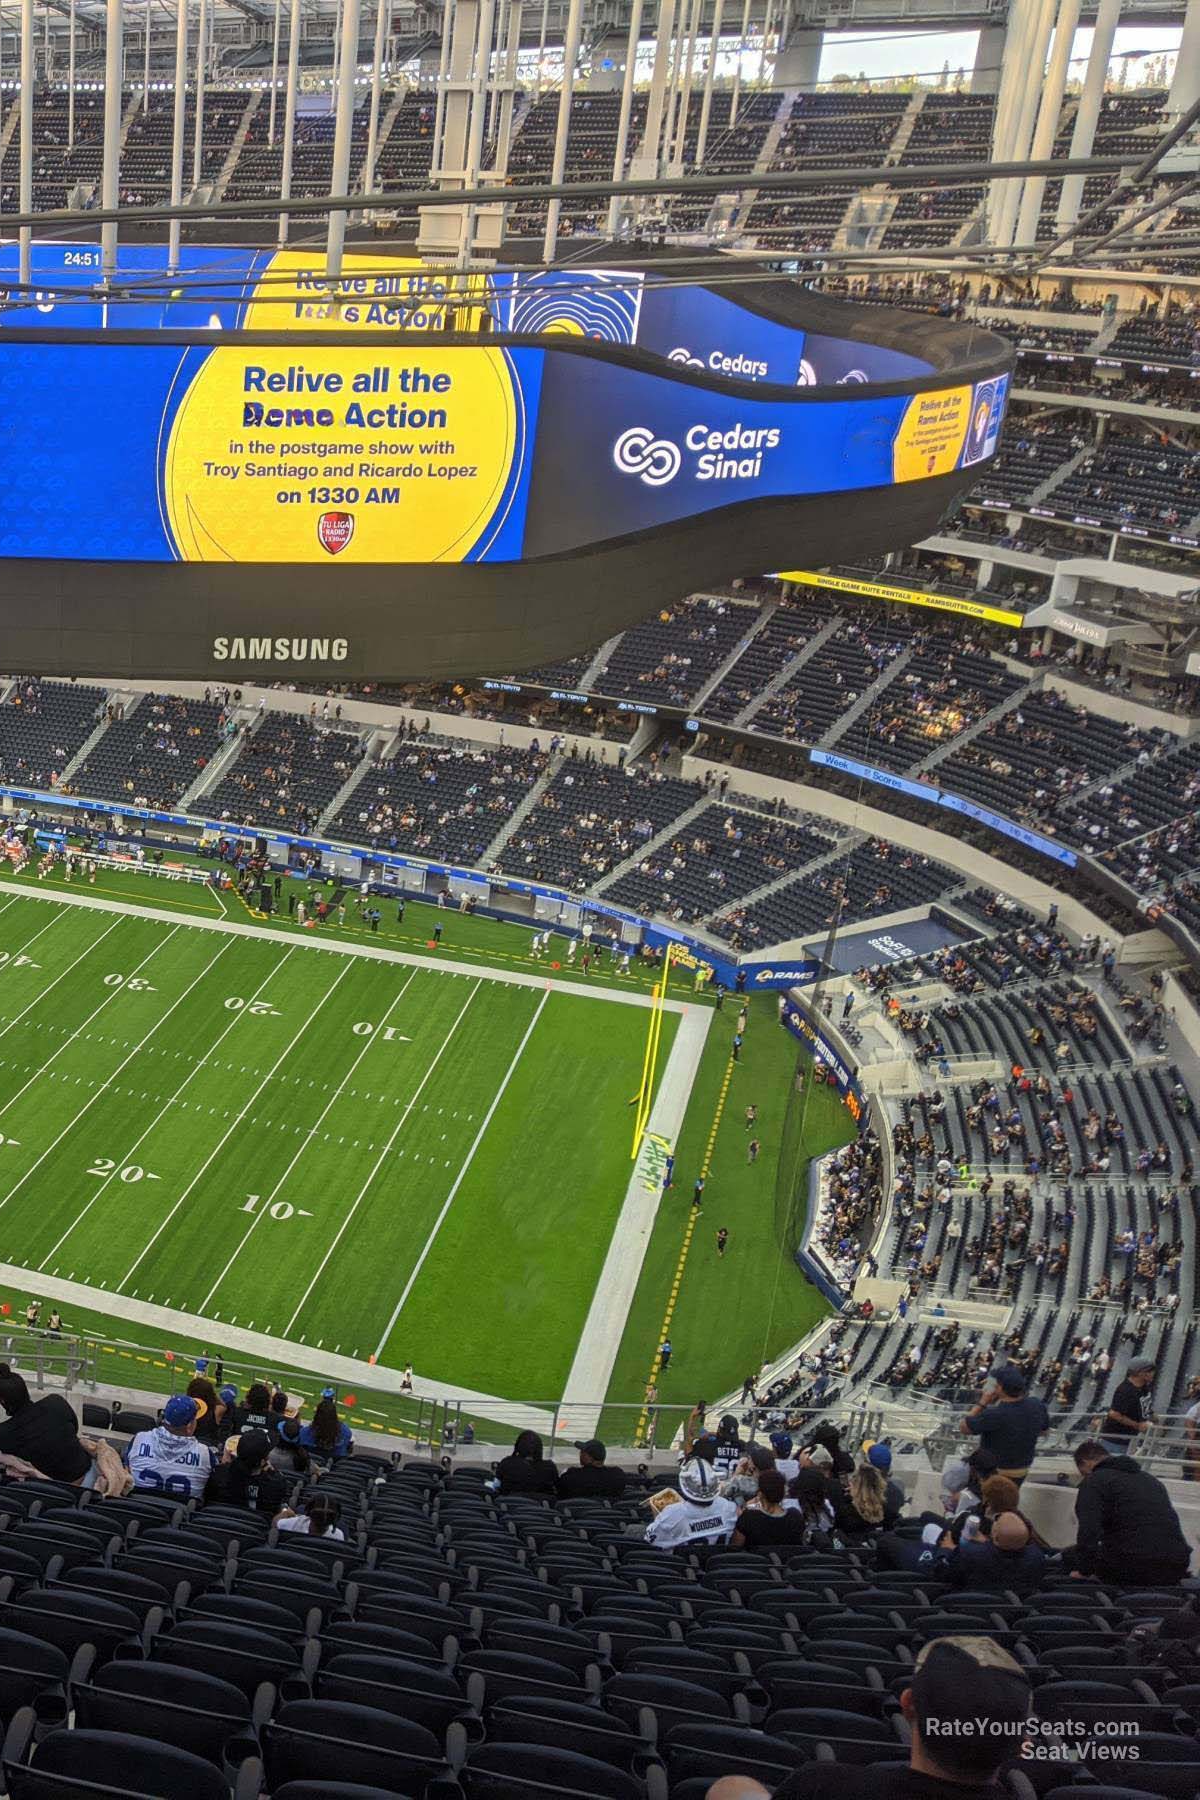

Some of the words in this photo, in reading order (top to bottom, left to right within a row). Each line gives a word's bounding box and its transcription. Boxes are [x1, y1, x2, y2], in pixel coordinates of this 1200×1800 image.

[64, 252, 100, 266] 24:51
[366, 303, 443, 328] Acton
[708, 351, 768, 377] Cedars
[243, 365, 343, 393] Relive
[351, 367, 389, 393] all
[399, 367, 451, 393] the
[345, 401, 447, 428] Action
[686, 423, 780, 452] Cedars
[229, 440, 244, 454] in
[248, 440, 276, 455] the
[280, 442, 364, 462] postgame
[369, 441, 414, 455] show
[418, 440, 455, 455] with
[203, 462, 240, 481] Troy
[244, 462, 319, 481] Santiago
[322, 463, 353, 478] and
[358, 463, 423, 478] Ricardo
[427, 463, 478, 481] Lopez
[695, 454, 762, 481] Sinai
[276, 491, 302, 504] on
[307, 487, 360, 504] 1330
[364, 487, 400, 504] AM
[322, 520, 332, 529] TU
[333, 520, 350, 529] LIGA
[325, 528, 346, 536] RADIO
[841, 582, 860, 592] GAME
[862, 585, 880, 595] SUITE
[213, 637, 348, 661] SAMSUNG
[825, 754, 849, 771] Week
[872, 770, 902, 789] Scores
[773, 971, 814, 980] RAMS
[86, 1158, 145, 1183] 20
[237, 1194, 295, 1220] 10
[247, 1414, 266, 1425] JACOBS
[717, 1447, 739, 1458] BETTS
[689, 1516, 725, 1533] WOODSON
